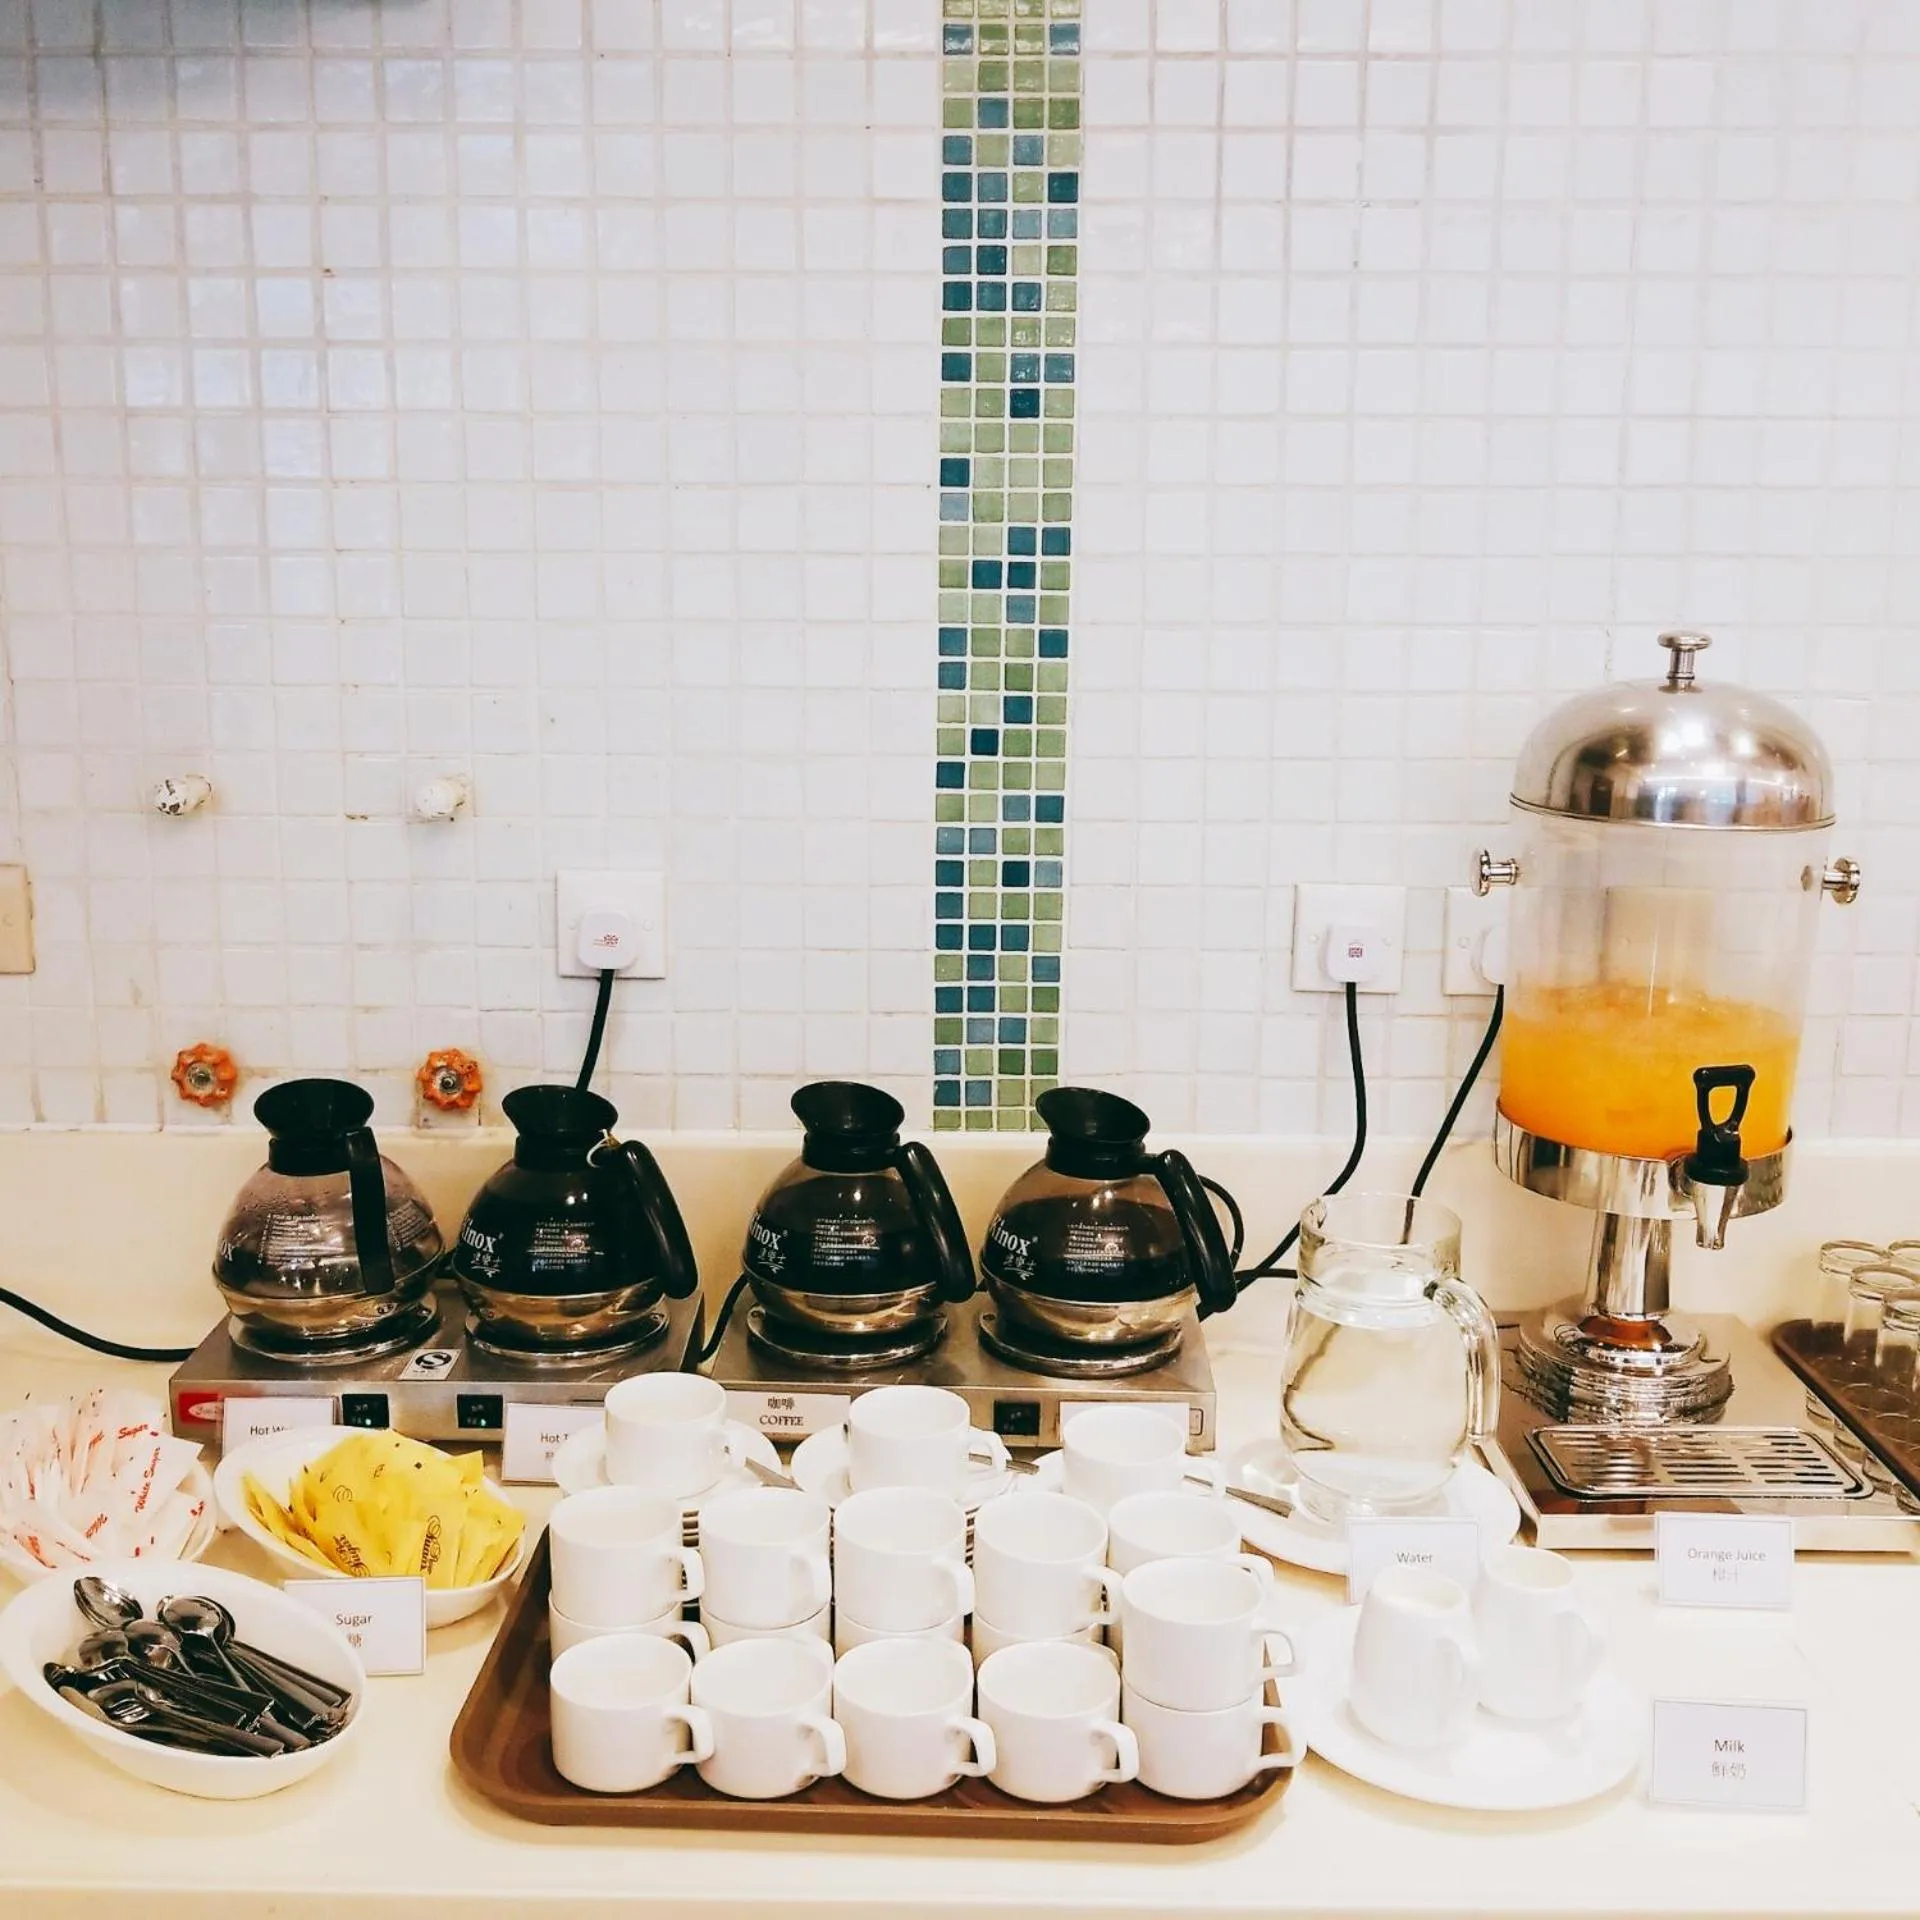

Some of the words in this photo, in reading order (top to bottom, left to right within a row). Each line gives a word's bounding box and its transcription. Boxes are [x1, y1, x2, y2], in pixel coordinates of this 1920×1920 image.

[767, 1396, 795, 1410] 咖啡
[759, 1415, 804, 1426] COFFEE
[250, 1425, 270, 1436] Hot
[540, 1433, 560, 1444] Hot
[1396, 1552, 1432, 1563] Water
[1687, 1547, 1733, 1562] Orange
[1735, 1549, 1767, 1561] Juice
[335, 1612, 372, 1627] Sugar
[1714, 1739, 1745, 1752] Milk
